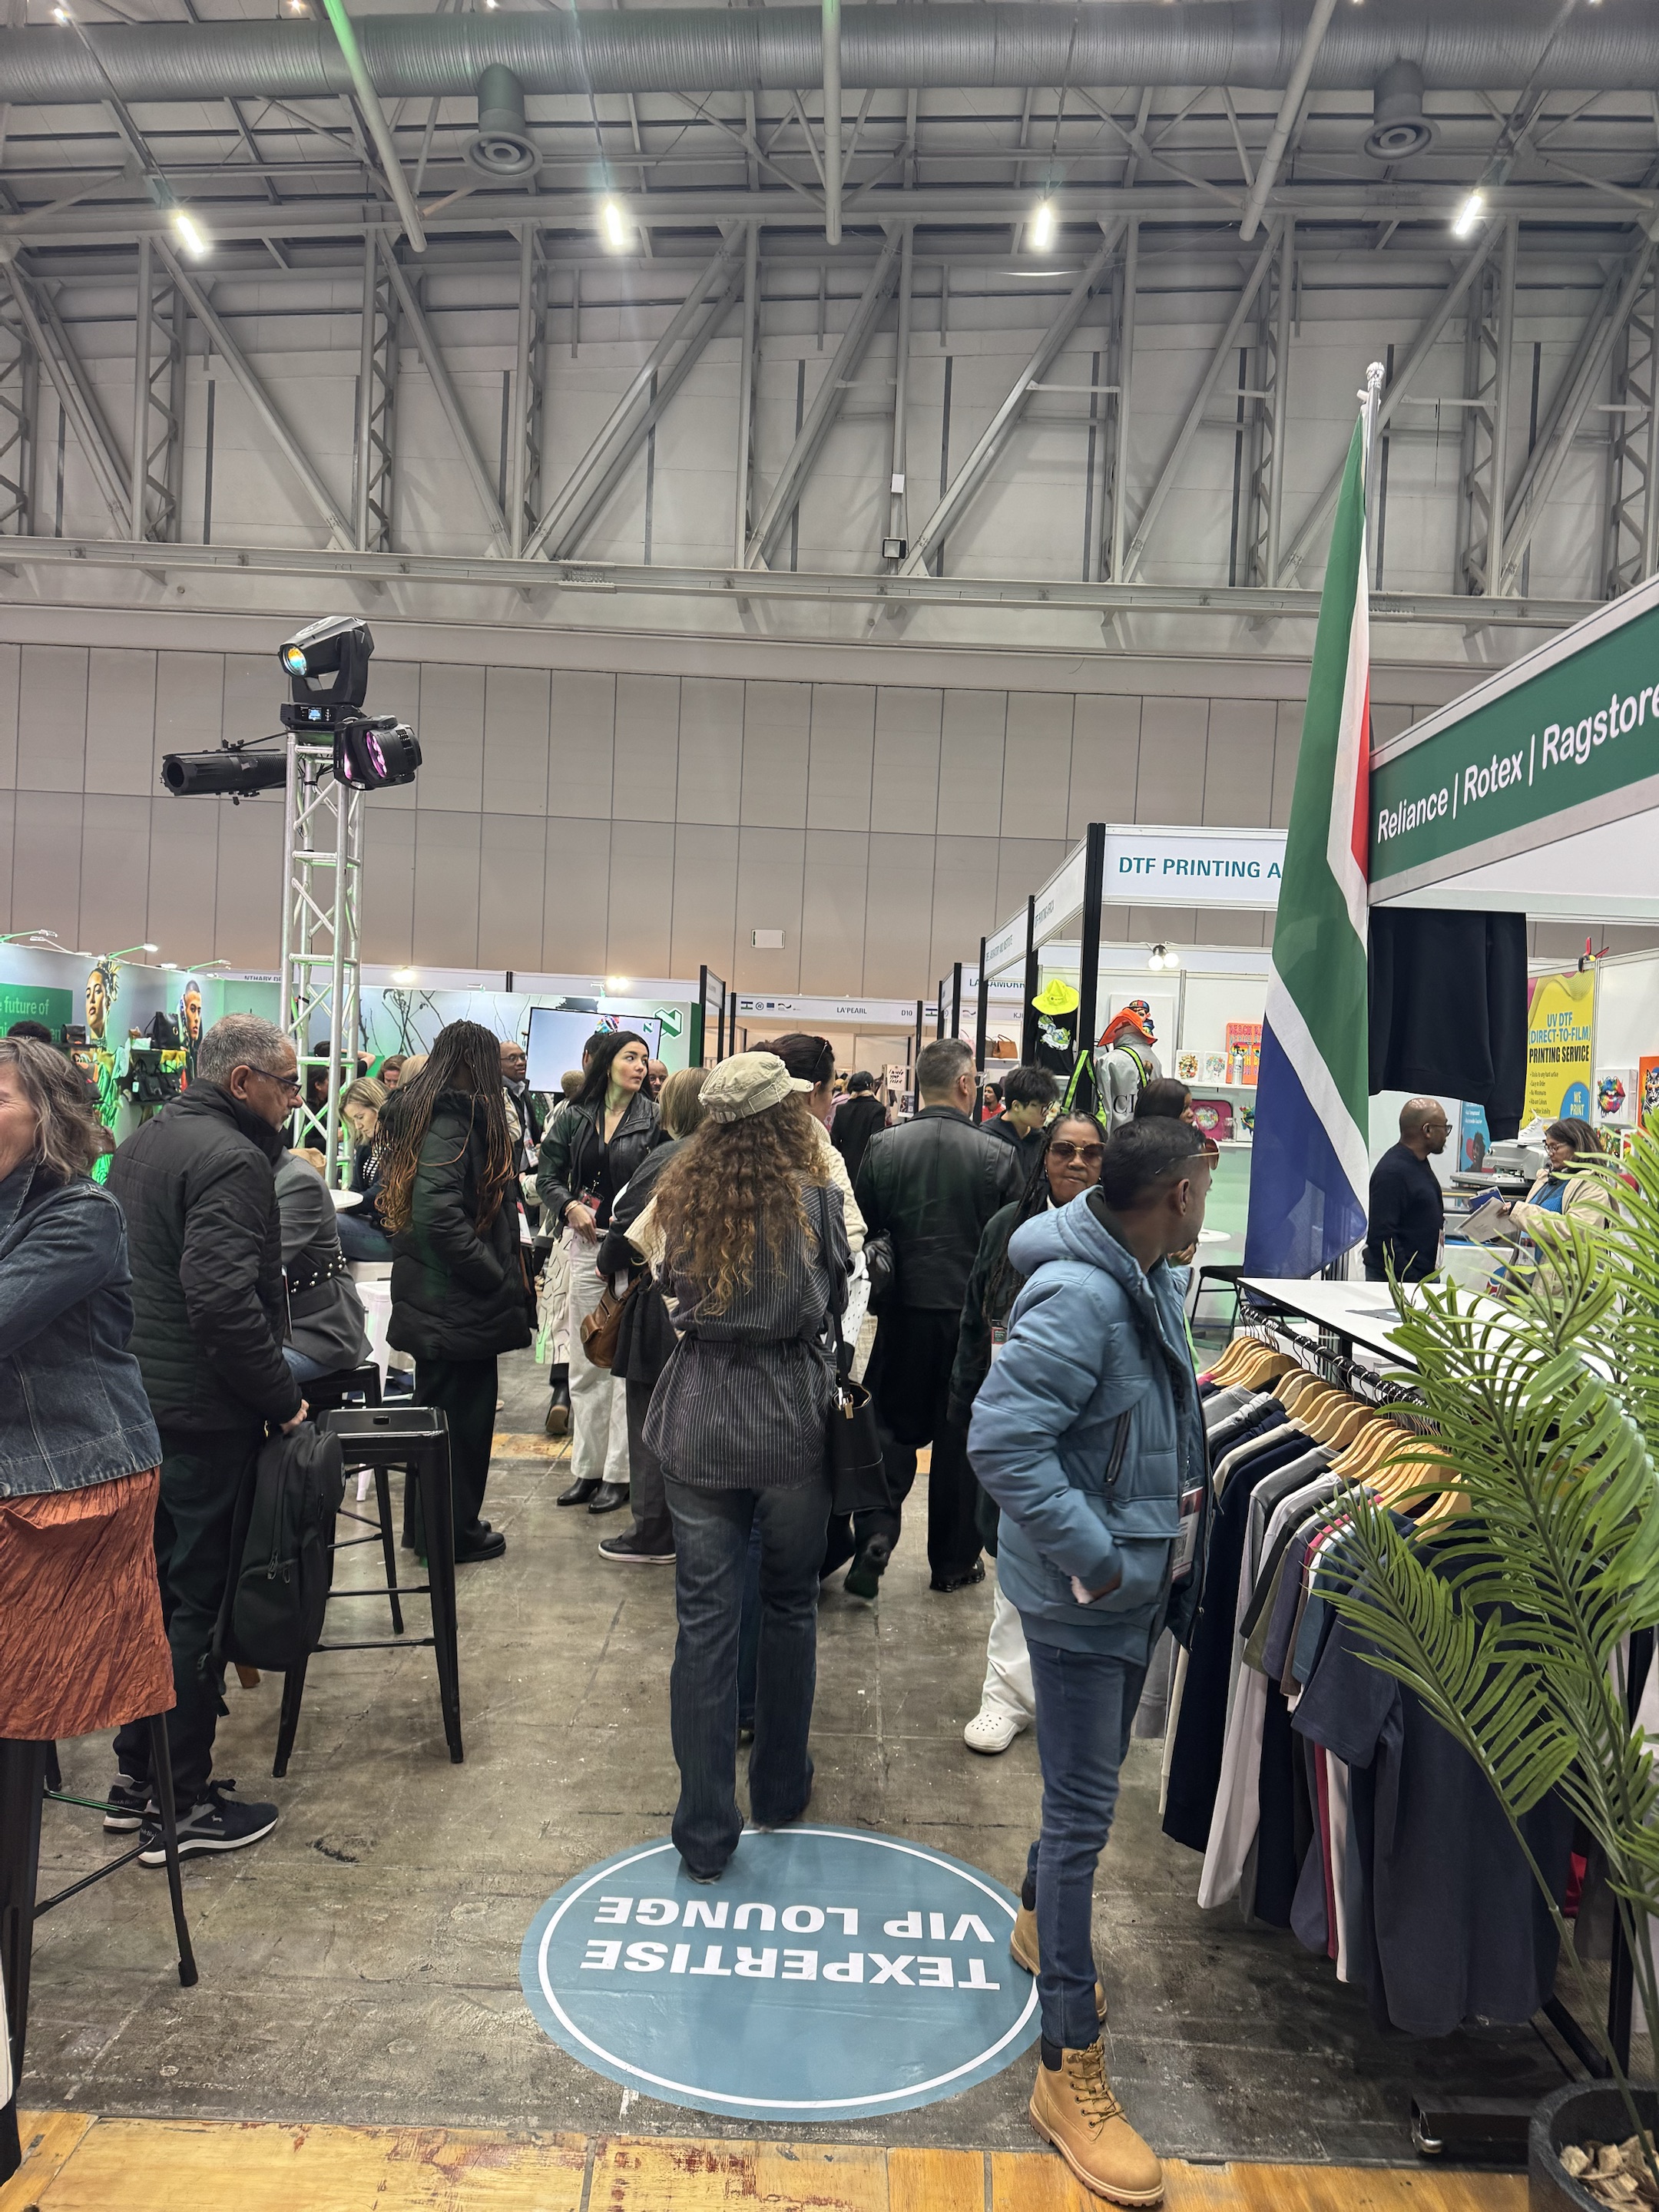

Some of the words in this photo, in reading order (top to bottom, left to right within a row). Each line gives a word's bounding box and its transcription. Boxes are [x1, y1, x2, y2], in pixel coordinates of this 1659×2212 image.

[1377, 787, 1449, 844] Reliance
[1463, 750, 1524, 806] Rotex
[1118, 856, 1157, 874] DTF
[1162, 858, 1261, 878] PRINTING
[4, 995, 37, 1015] future
[38, 998, 50, 1015] of
[836, 1006, 867, 1015] LA'PEARL
[1547, 1013, 1558, 1028] UV
[1558, 1012, 1573, 1027] DTF
[1528, 1046, 1561, 1064] PRINTING
[1561, 1045, 1589, 1063] SERVICE
[1574, 1091, 1581, 1103] WE
[1570, 1104, 1584, 1116] PRINT
[593, 1896, 859, 1936] LOUNGE
[883, 1911, 995, 1943] VIP
[580, 1939, 1001, 1990] TEXPERTISE
